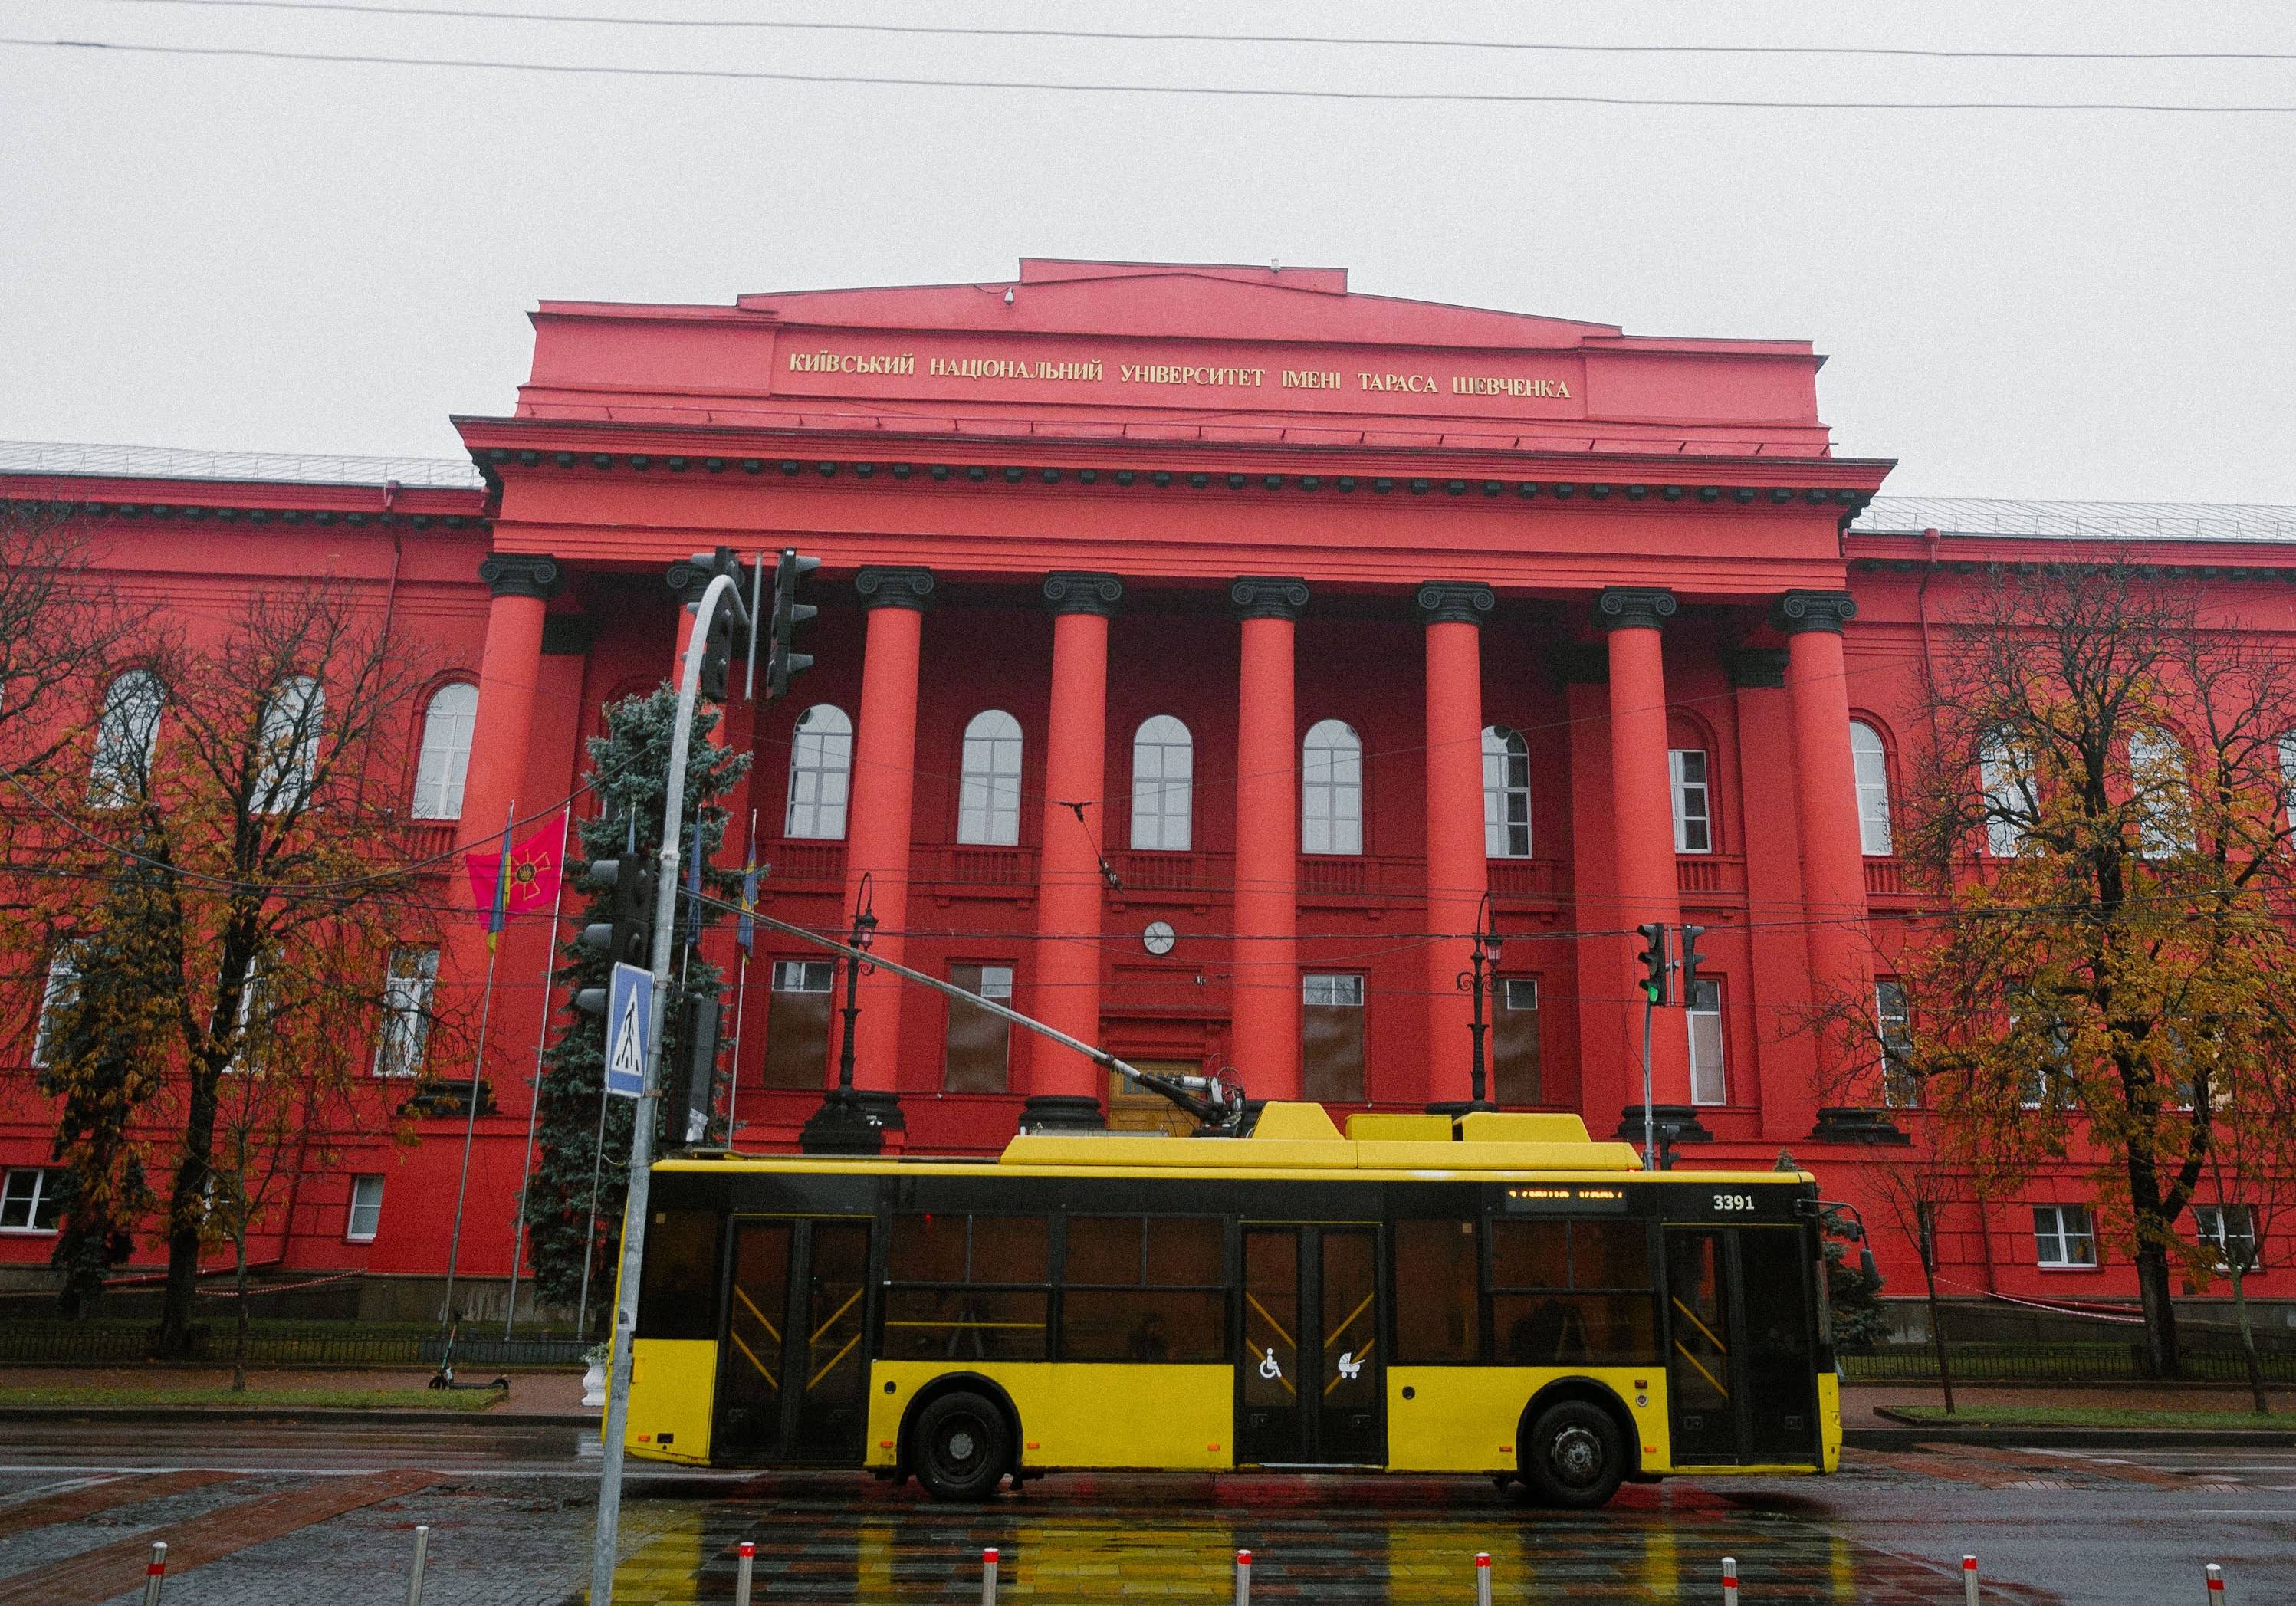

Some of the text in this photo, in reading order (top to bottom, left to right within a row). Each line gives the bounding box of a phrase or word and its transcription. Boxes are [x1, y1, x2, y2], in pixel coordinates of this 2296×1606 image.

[789, 350, 1572, 399] КИЇВСЬКИЙ НАЦІОНАЛЬНИЙ УНІВЕРСИТЕТ ІМЕНІ ТАРАСА ШЕВЧЕНКА
[1713, 1194, 1756, 1210] 3391
